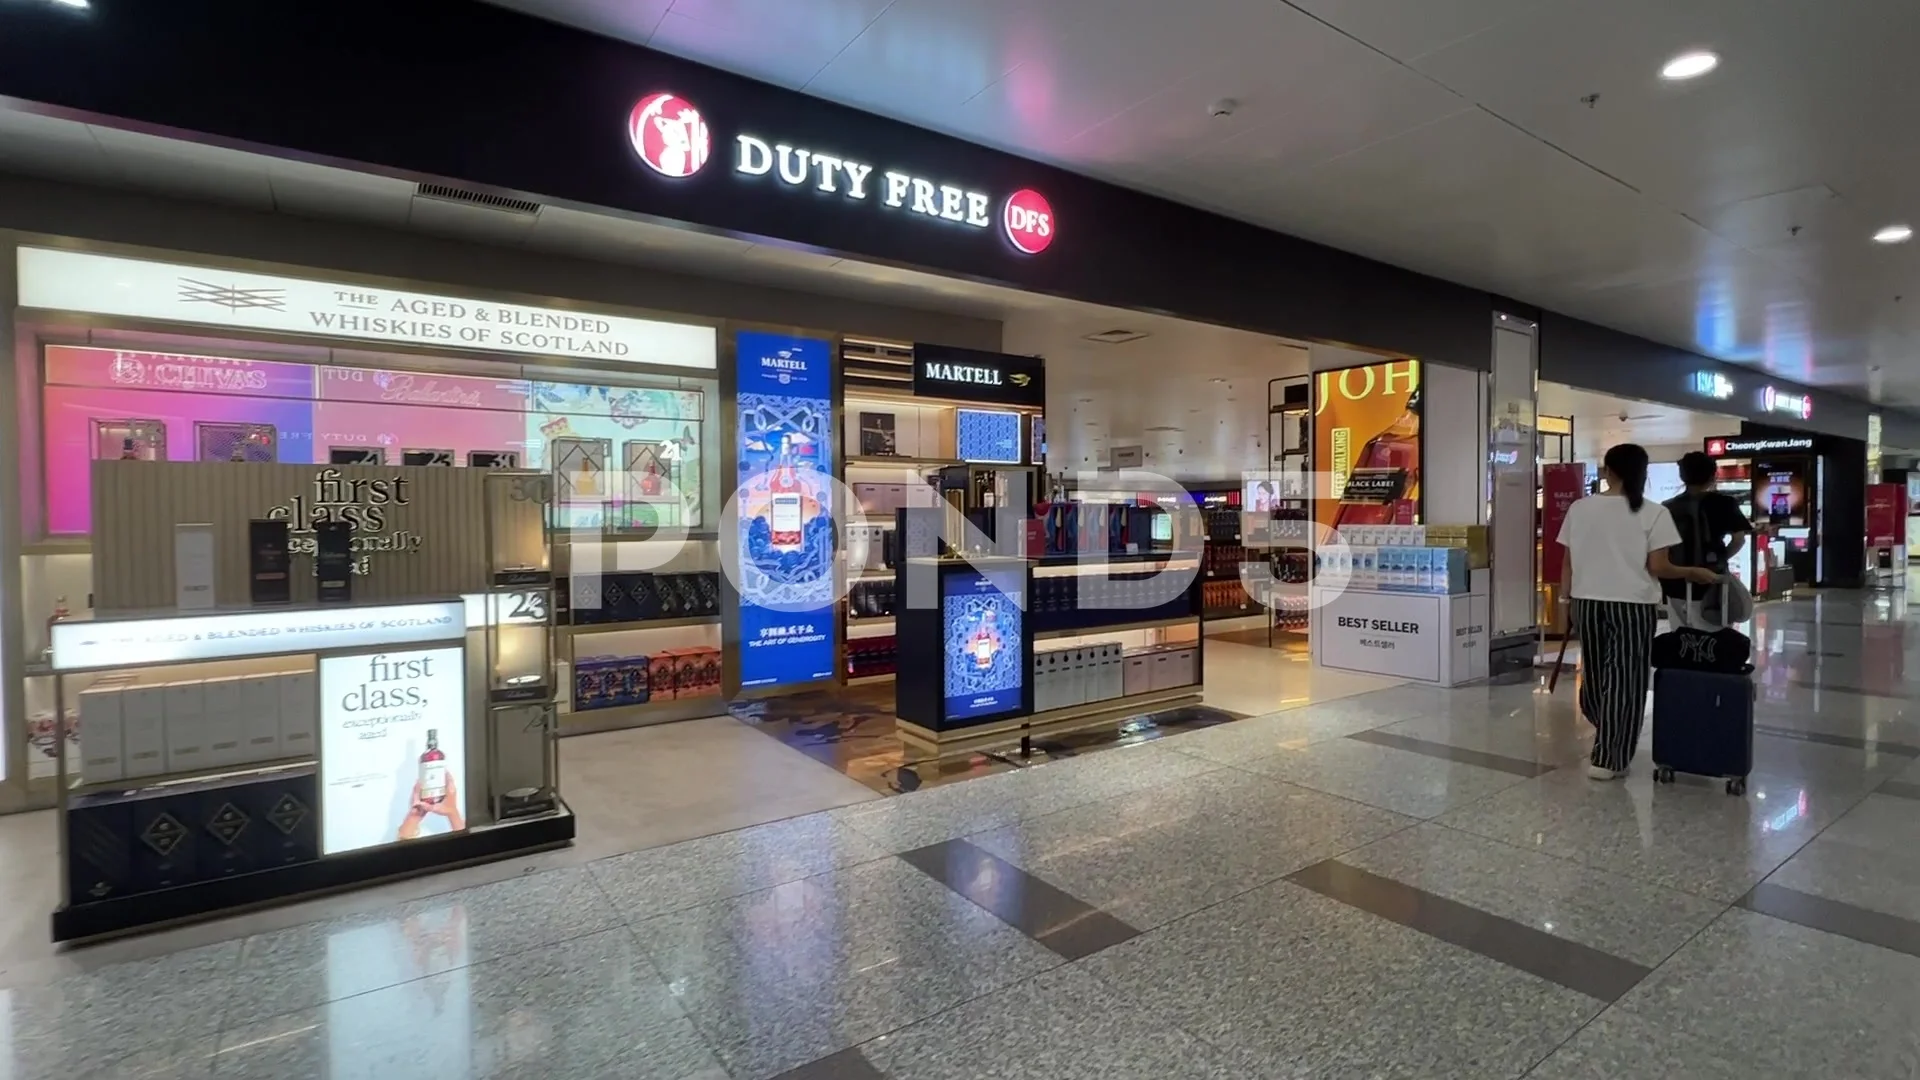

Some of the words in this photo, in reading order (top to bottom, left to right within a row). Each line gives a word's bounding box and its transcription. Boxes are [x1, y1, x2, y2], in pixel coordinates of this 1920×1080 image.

[736, 133, 872, 200] DUTY
[884, 170, 989, 228] FREE
[1011, 204, 1050, 237] DFS
[334, 290, 379, 305] THE
[391, 298, 466, 319] AGED
[474, 307, 490, 322] &
[498, 308, 610, 335] BLENDED
[309, 311, 452, 339] WHISKIES
[459, 326, 491, 342] OF
[500, 331, 629, 357] SCOTLAND
[761, 357, 808, 371] MARTELL
[925, 362, 1003, 386] MARTELL
[1334, 431, 1347, 472] WALKING
[1725, 438, 1813, 451] CheongKwanJang
[313, 468, 410, 506] first
[1338, 616, 1369, 629] BEST
[1371, 619, 1420, 634] SELLER
[1359, 638, 1395, 650] 베스트셀러
[368, 654, 434, 683] first
[341, 684, 429, 712] class,
